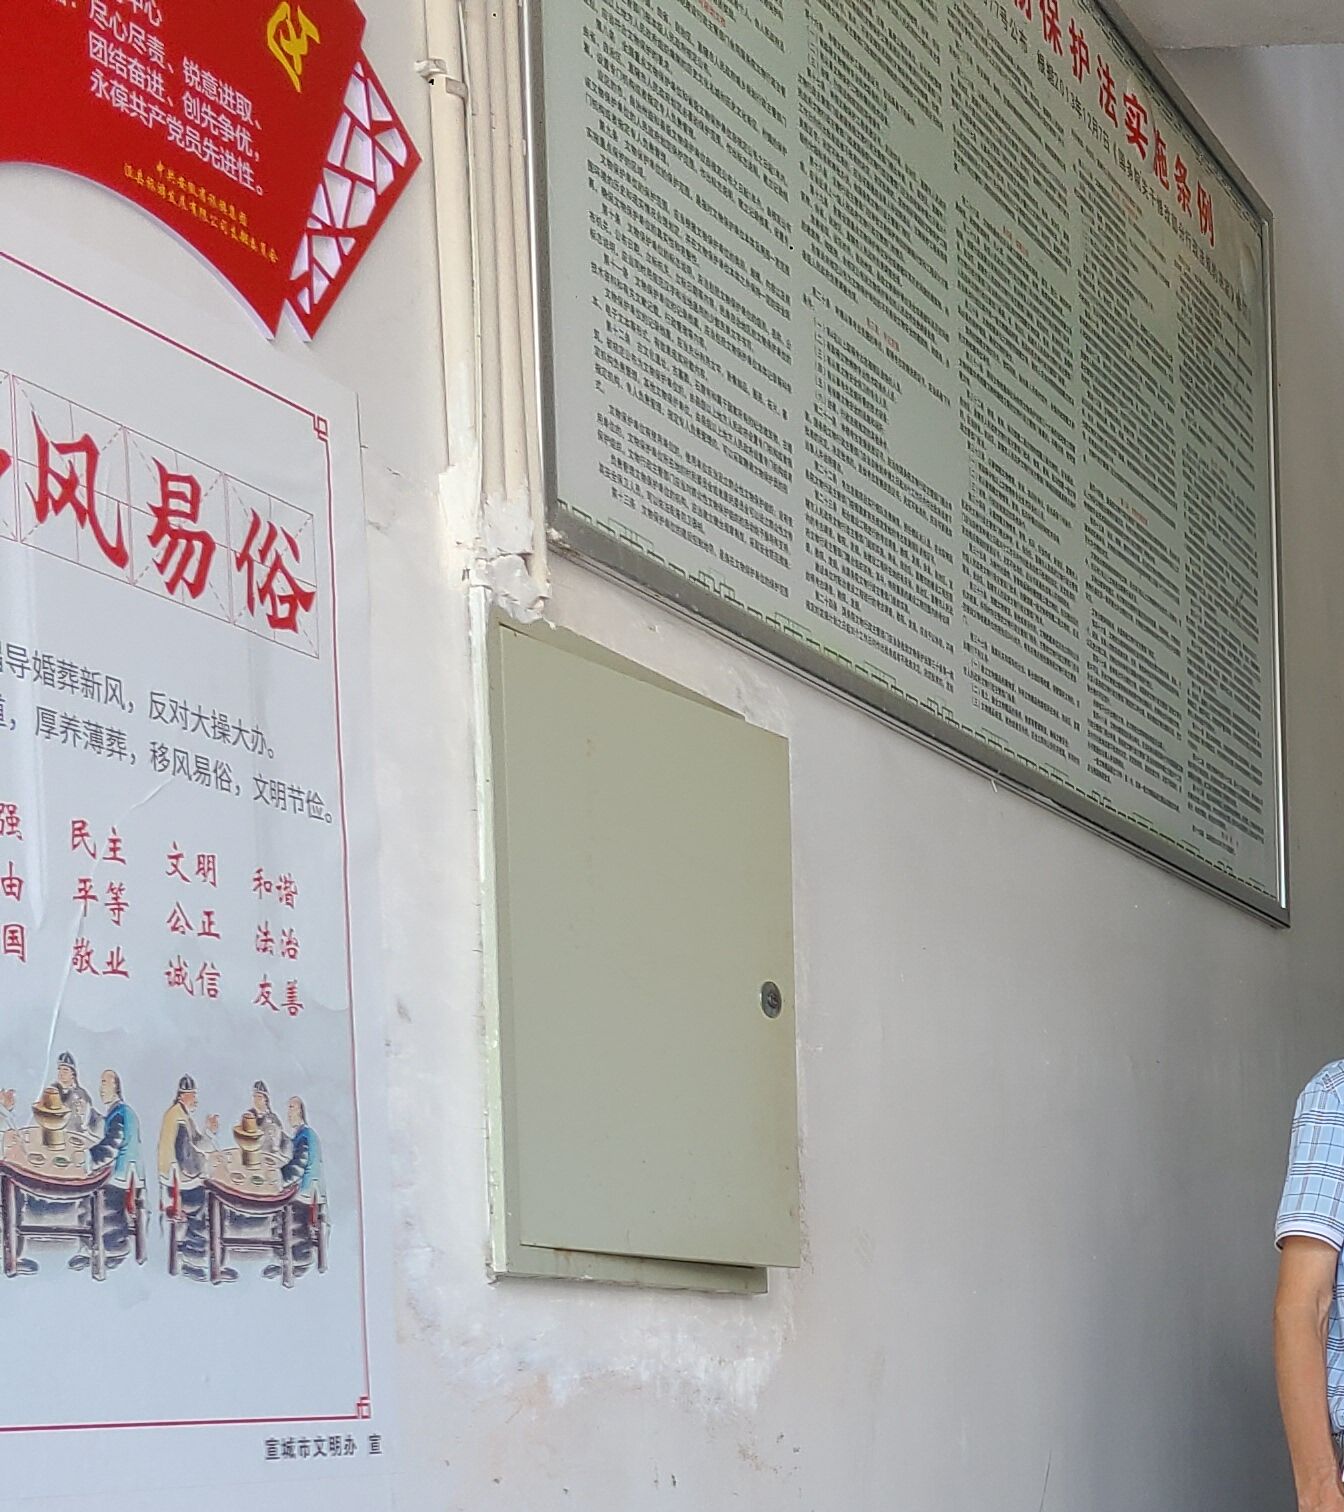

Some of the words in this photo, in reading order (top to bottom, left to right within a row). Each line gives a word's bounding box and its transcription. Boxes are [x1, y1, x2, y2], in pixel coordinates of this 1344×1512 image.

[90, 69, 264, 197] 永葆共产党员先进性。
[0, 410, 317, 634] 风易俗
[0, 694, 333, 825] ，厚养薄葬，移风易俗，文明节俭。
[1, 861, 24, 902] 由
[72, 877, 129, 927] 平等
[165, 901, 221, 940] 公正
[254, 920, 300, 961] 法治
[71, 819, 127, 866] 民主
[165, 841, 218, 887] 文明
[252, 867, 299, 910] 和谐
[2, 923, 27, 964] 国
[70, 937, 130, 978] 敬业
[163, 954, 221, 1000] 诚信
[252, 973, 305, 1018] 友善
[264, 1436, 358, 1461] 宣城市文明办
